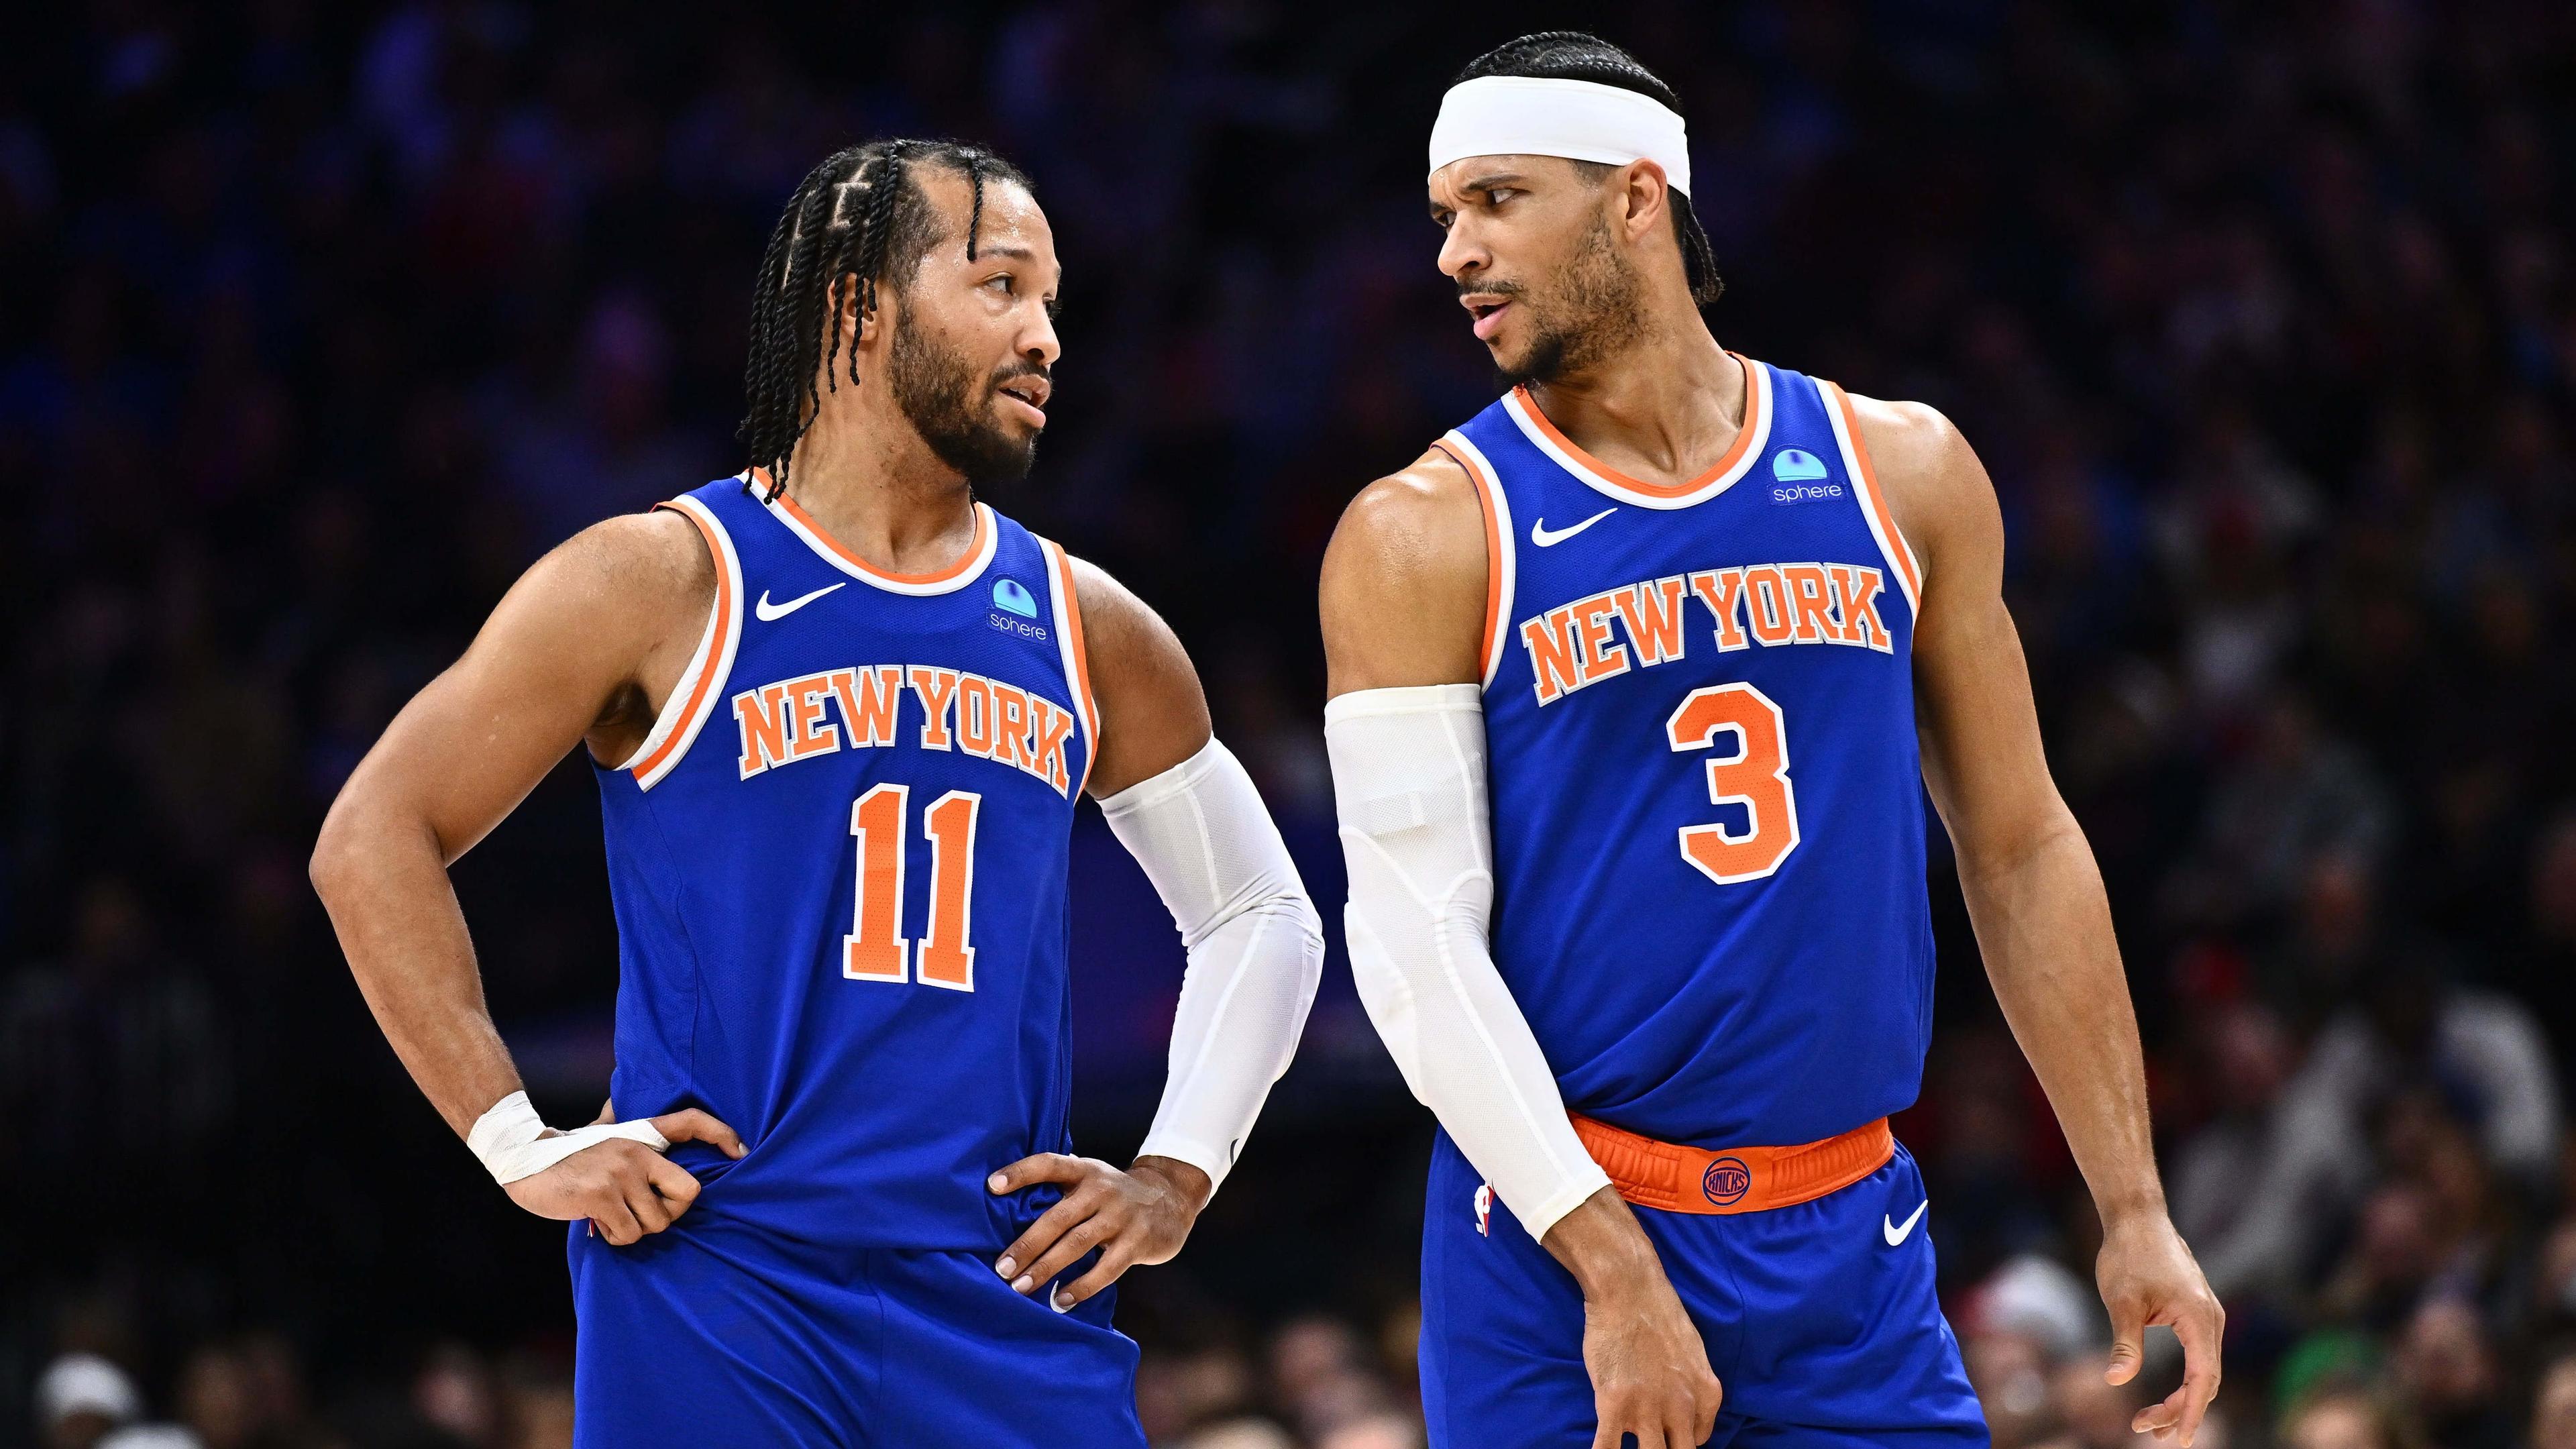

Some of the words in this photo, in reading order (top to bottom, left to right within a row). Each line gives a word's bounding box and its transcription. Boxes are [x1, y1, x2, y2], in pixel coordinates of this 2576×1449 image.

[1774, 485, 1842, 502] sphere
[990, 614, 1046, 640] sphere
[1520, 574, 1685, 708] NEW
[1687, 562, 1893, 654] YORK
[732, 665, 904, 781] NEW
[906, 665, 1074, 800] YORK
[1666, 682, 1801, 885] 3
[843, 783, 981, 992] 11
[1708, 1171, 1746, 1193] KNICKS
